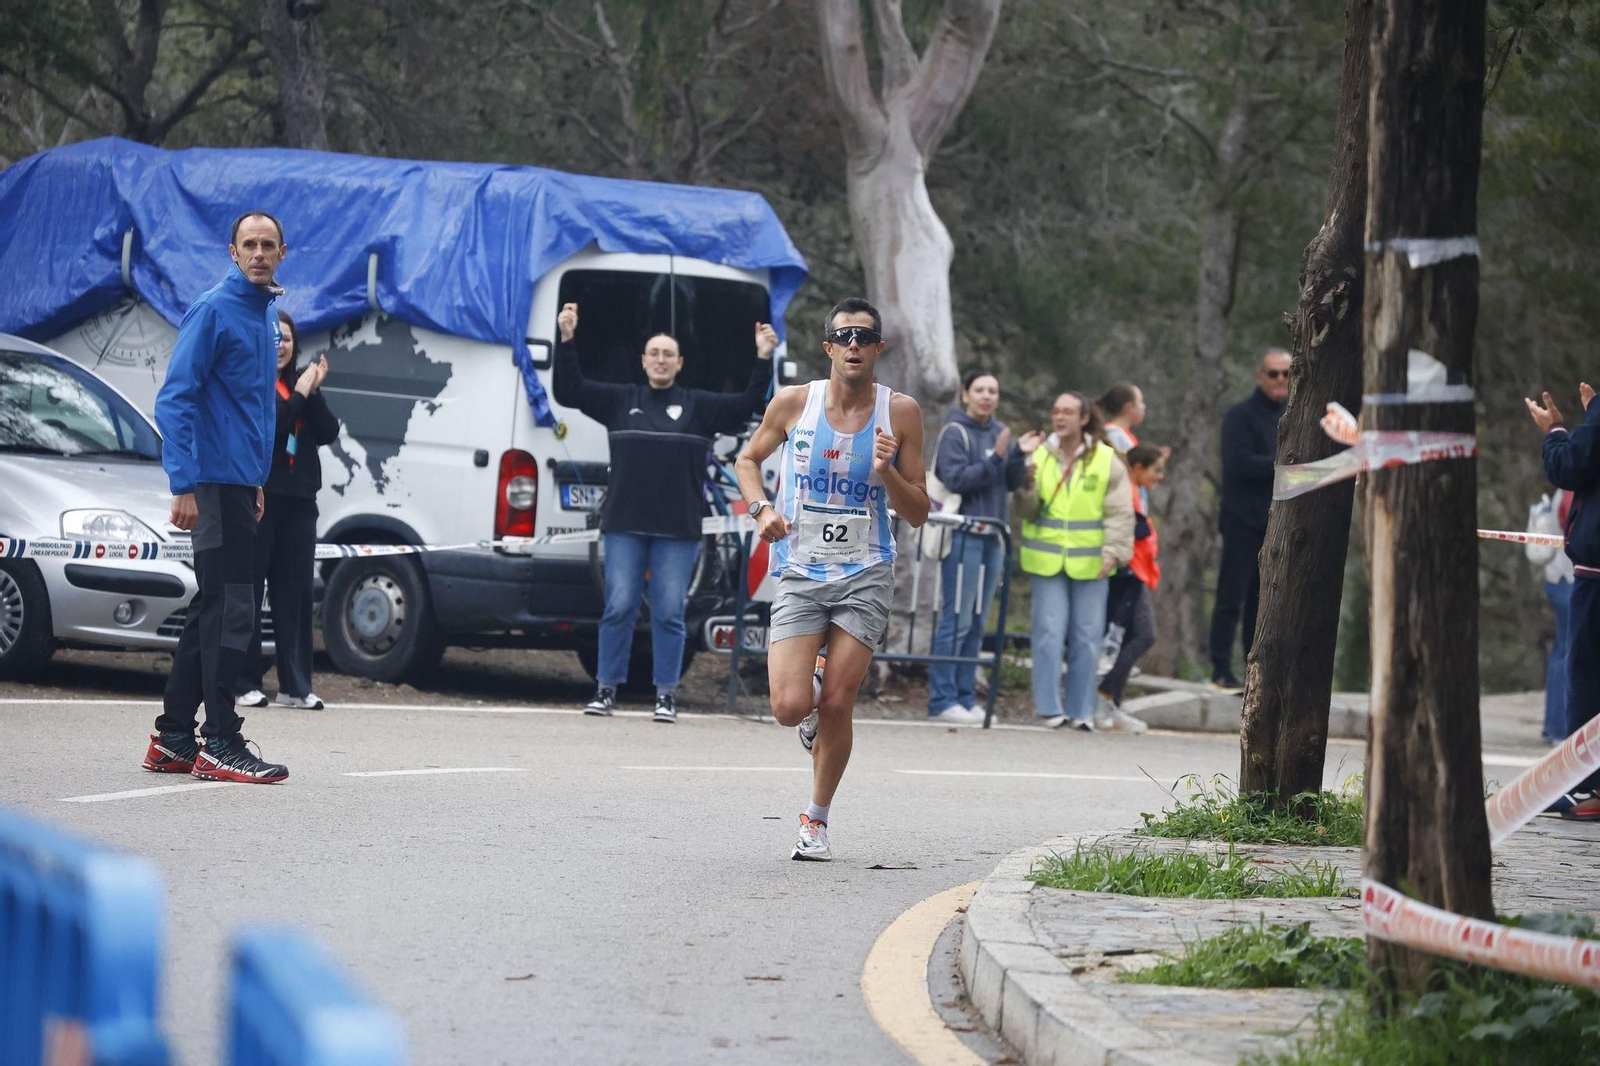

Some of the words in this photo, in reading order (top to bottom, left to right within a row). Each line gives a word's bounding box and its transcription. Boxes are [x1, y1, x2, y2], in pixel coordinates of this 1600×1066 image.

[795, 467, 881, 502] málaga
[571, 486, 588, 504] SN
[822, 523, 848, 543] 62
[29, 541, 54, 549] PROHIBIDO
